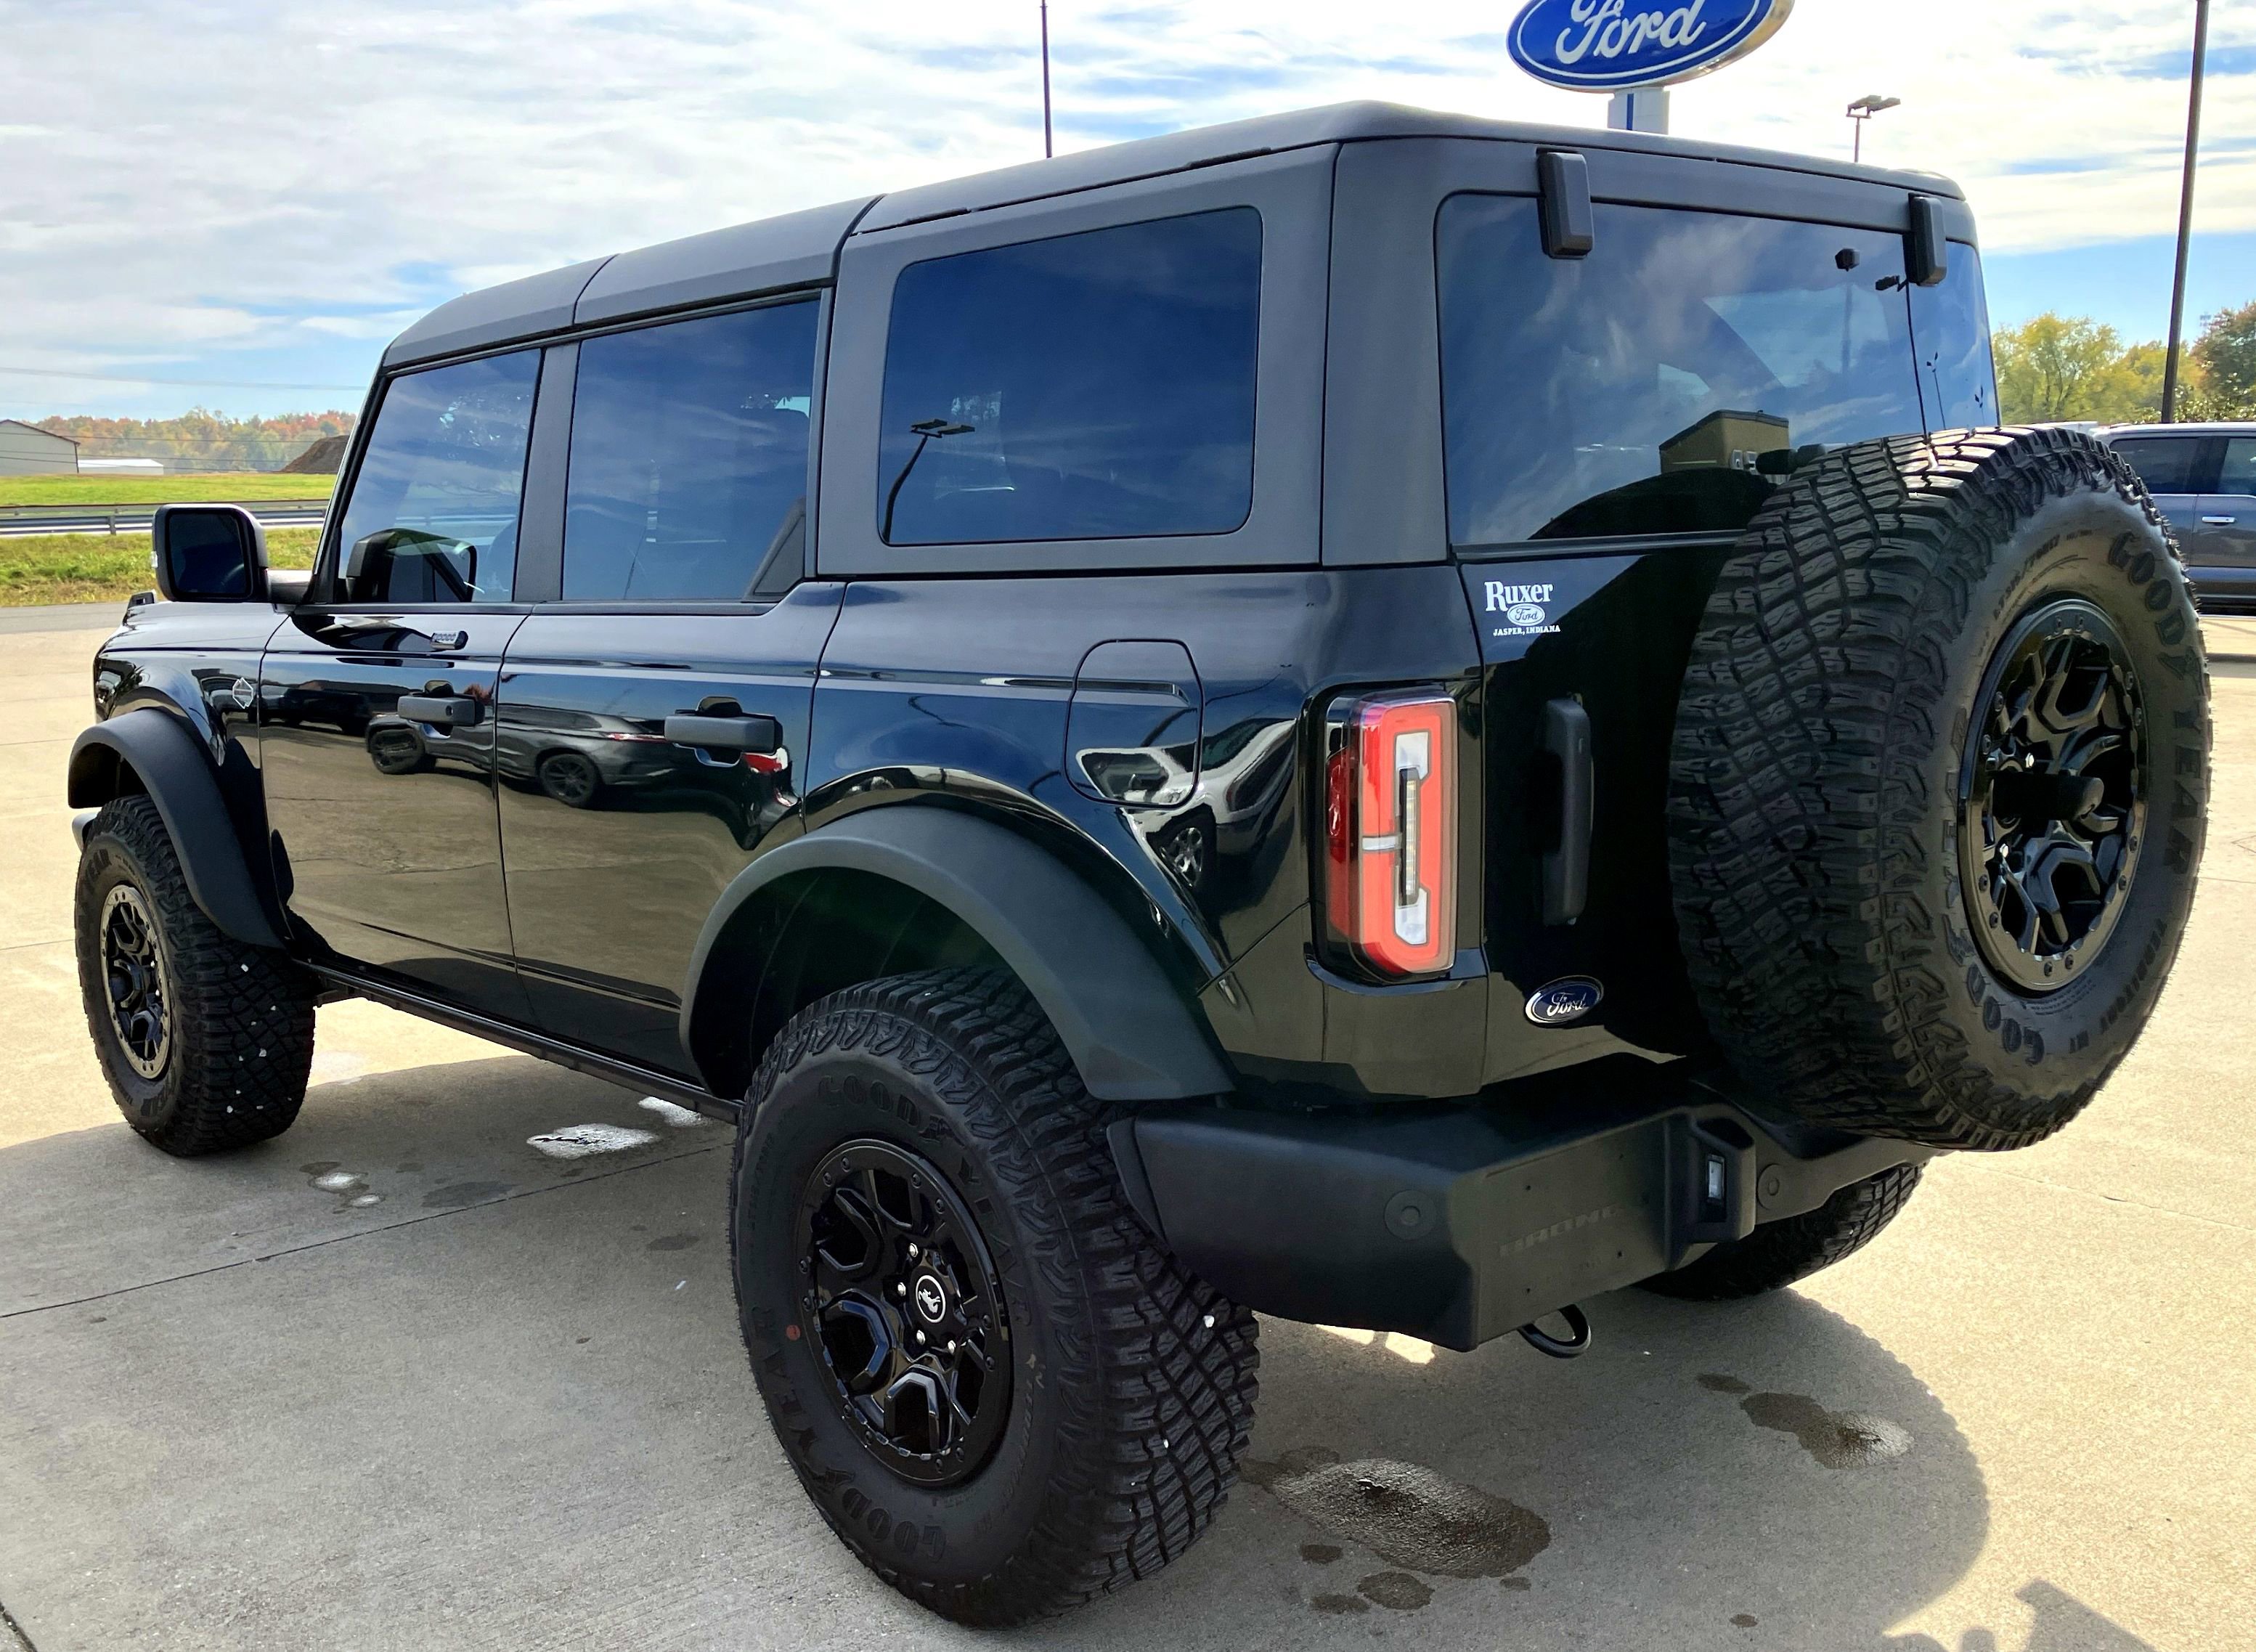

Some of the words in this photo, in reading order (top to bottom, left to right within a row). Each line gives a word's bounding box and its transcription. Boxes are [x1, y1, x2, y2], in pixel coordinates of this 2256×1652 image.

[1555, 0, 1708, 65] Ford
[1483, 580, 1554, 612] Ruxer
[1515, 608, 1539, 622] Ford
[1492, 627, 1526, 637] JASPER,
[1526, 624, 1561, 635] INDIANA
[2107, 529, 2203, 876] GOODYEAR
[1546, 992, 1589, 1017] Ford
